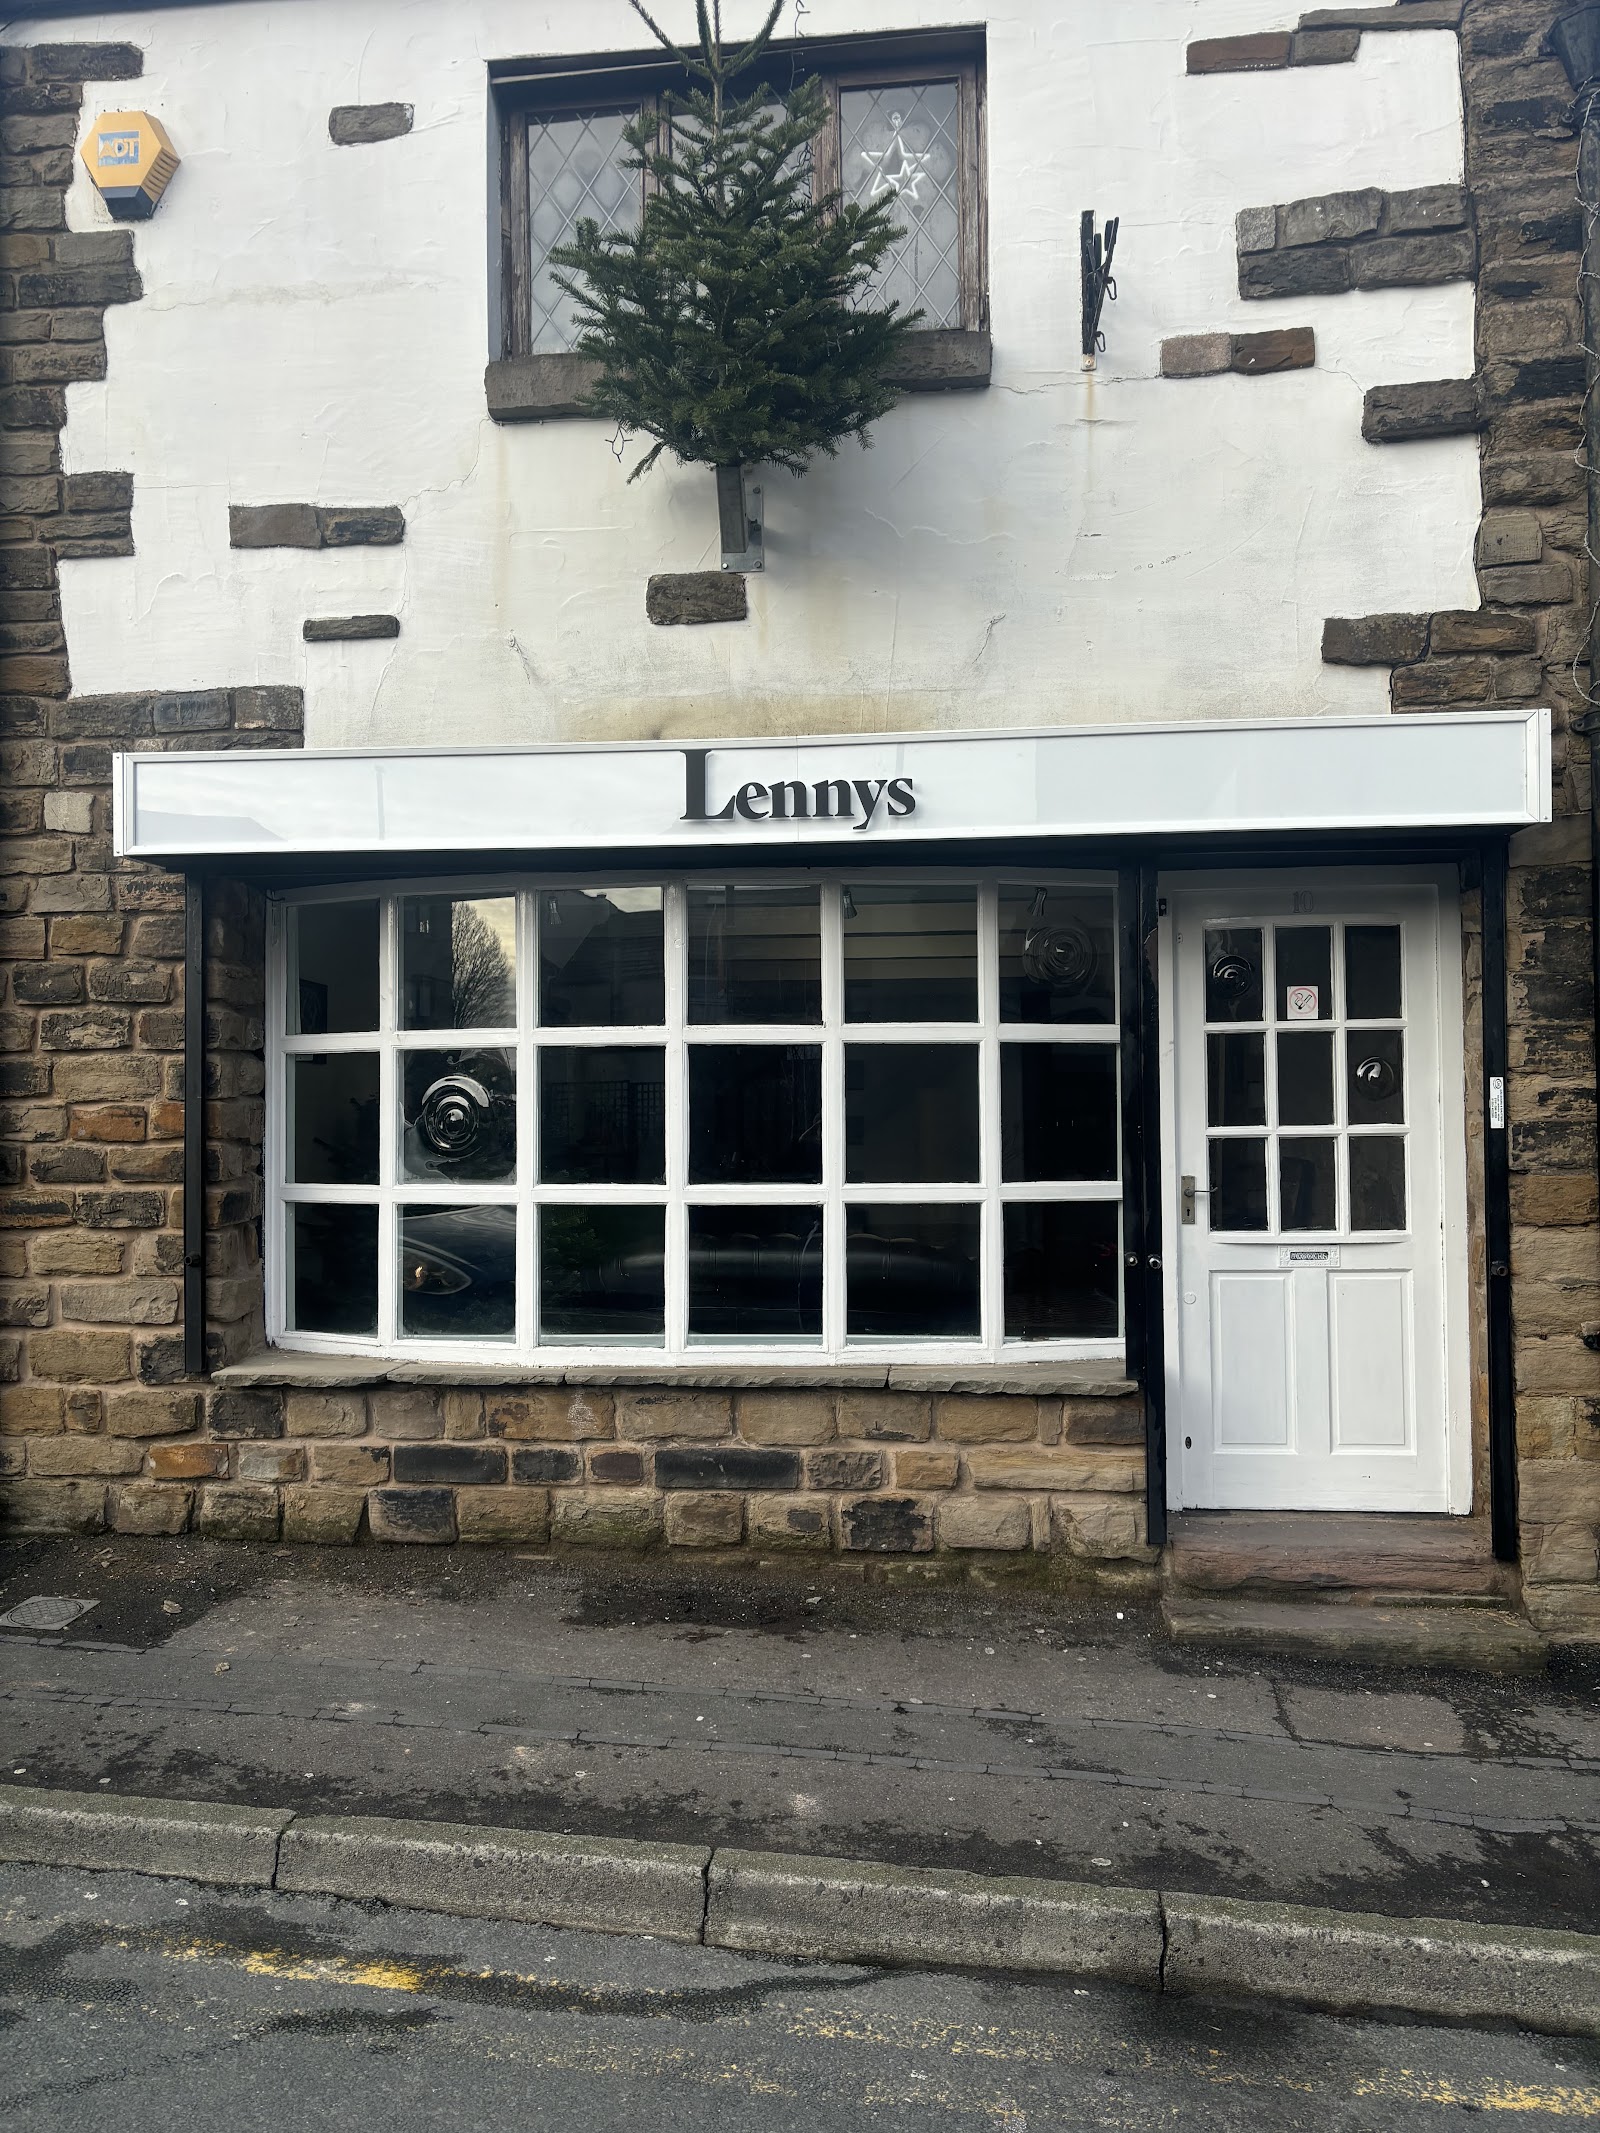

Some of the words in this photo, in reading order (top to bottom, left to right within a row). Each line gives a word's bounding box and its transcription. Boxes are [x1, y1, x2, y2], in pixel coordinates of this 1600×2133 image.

[100, 137, 140, 157] ADT
[679, 749, 916, 830] Lennys
[1292, 890, 1313, 914] 10
